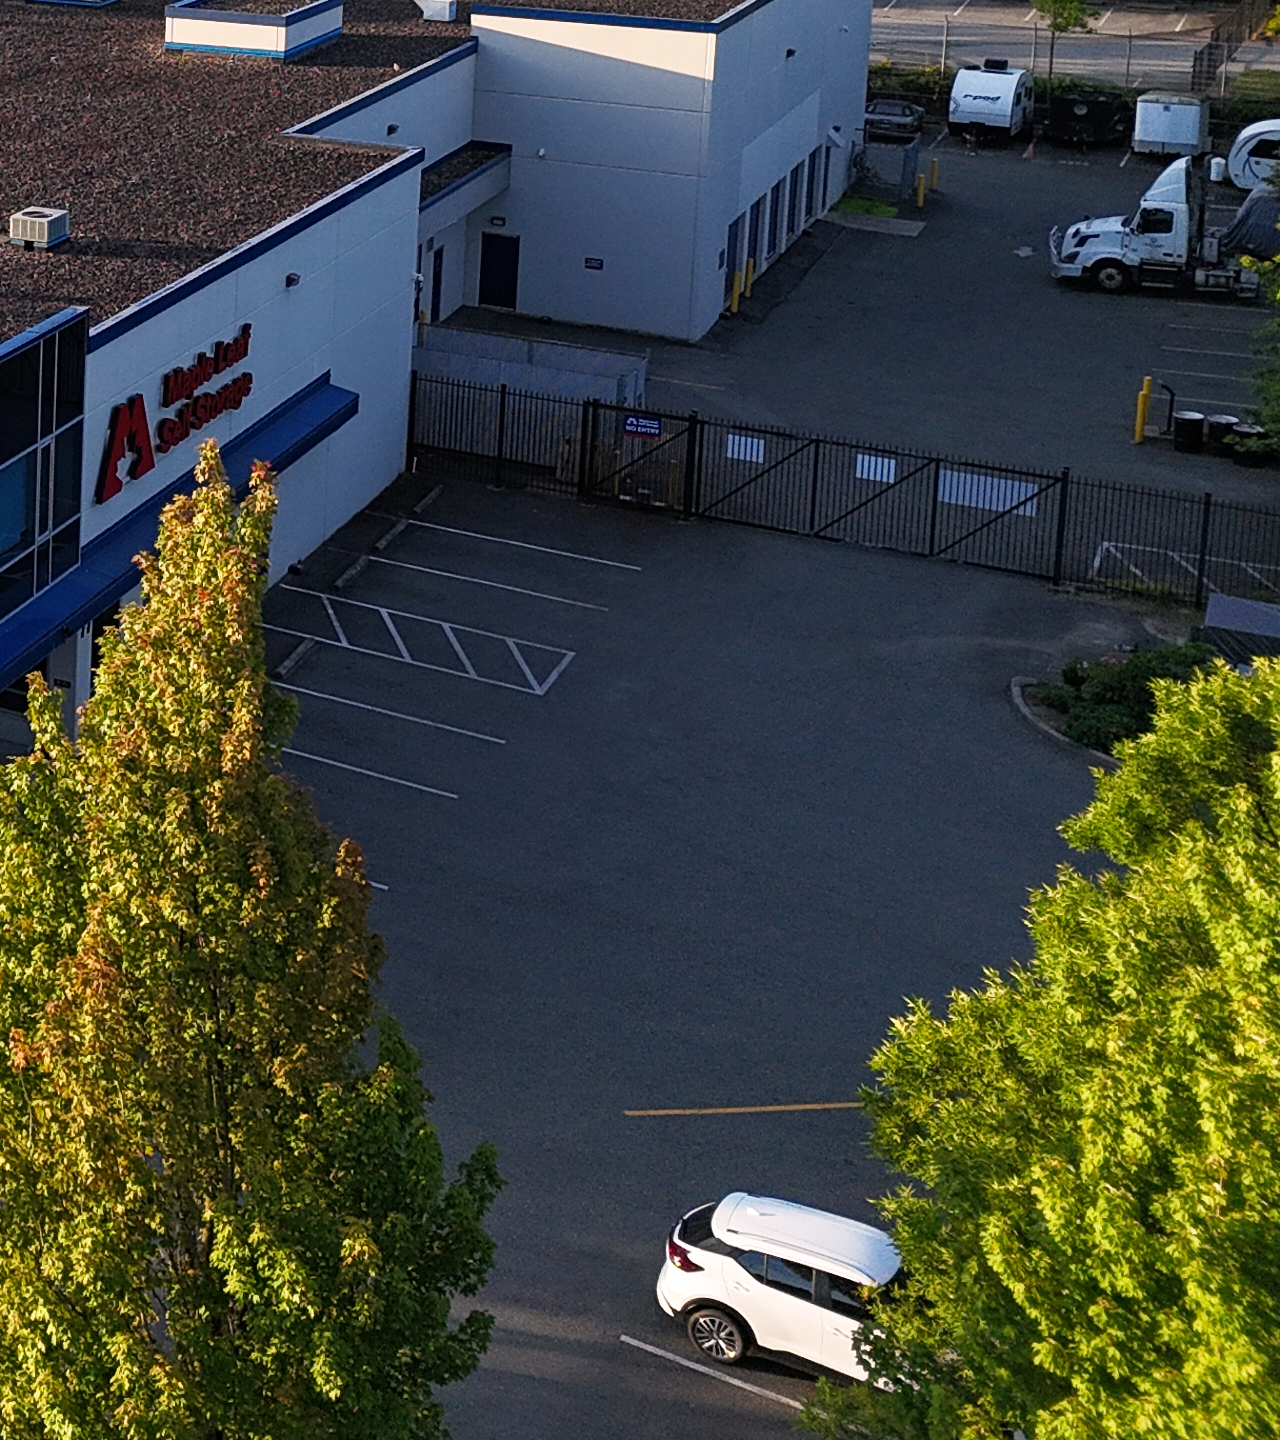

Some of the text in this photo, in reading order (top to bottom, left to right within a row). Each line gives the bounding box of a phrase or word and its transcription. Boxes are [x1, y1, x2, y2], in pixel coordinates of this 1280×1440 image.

[162, 322, 252, 408] Maple Leaf
[156, 372, 253, 453] Self Storage
